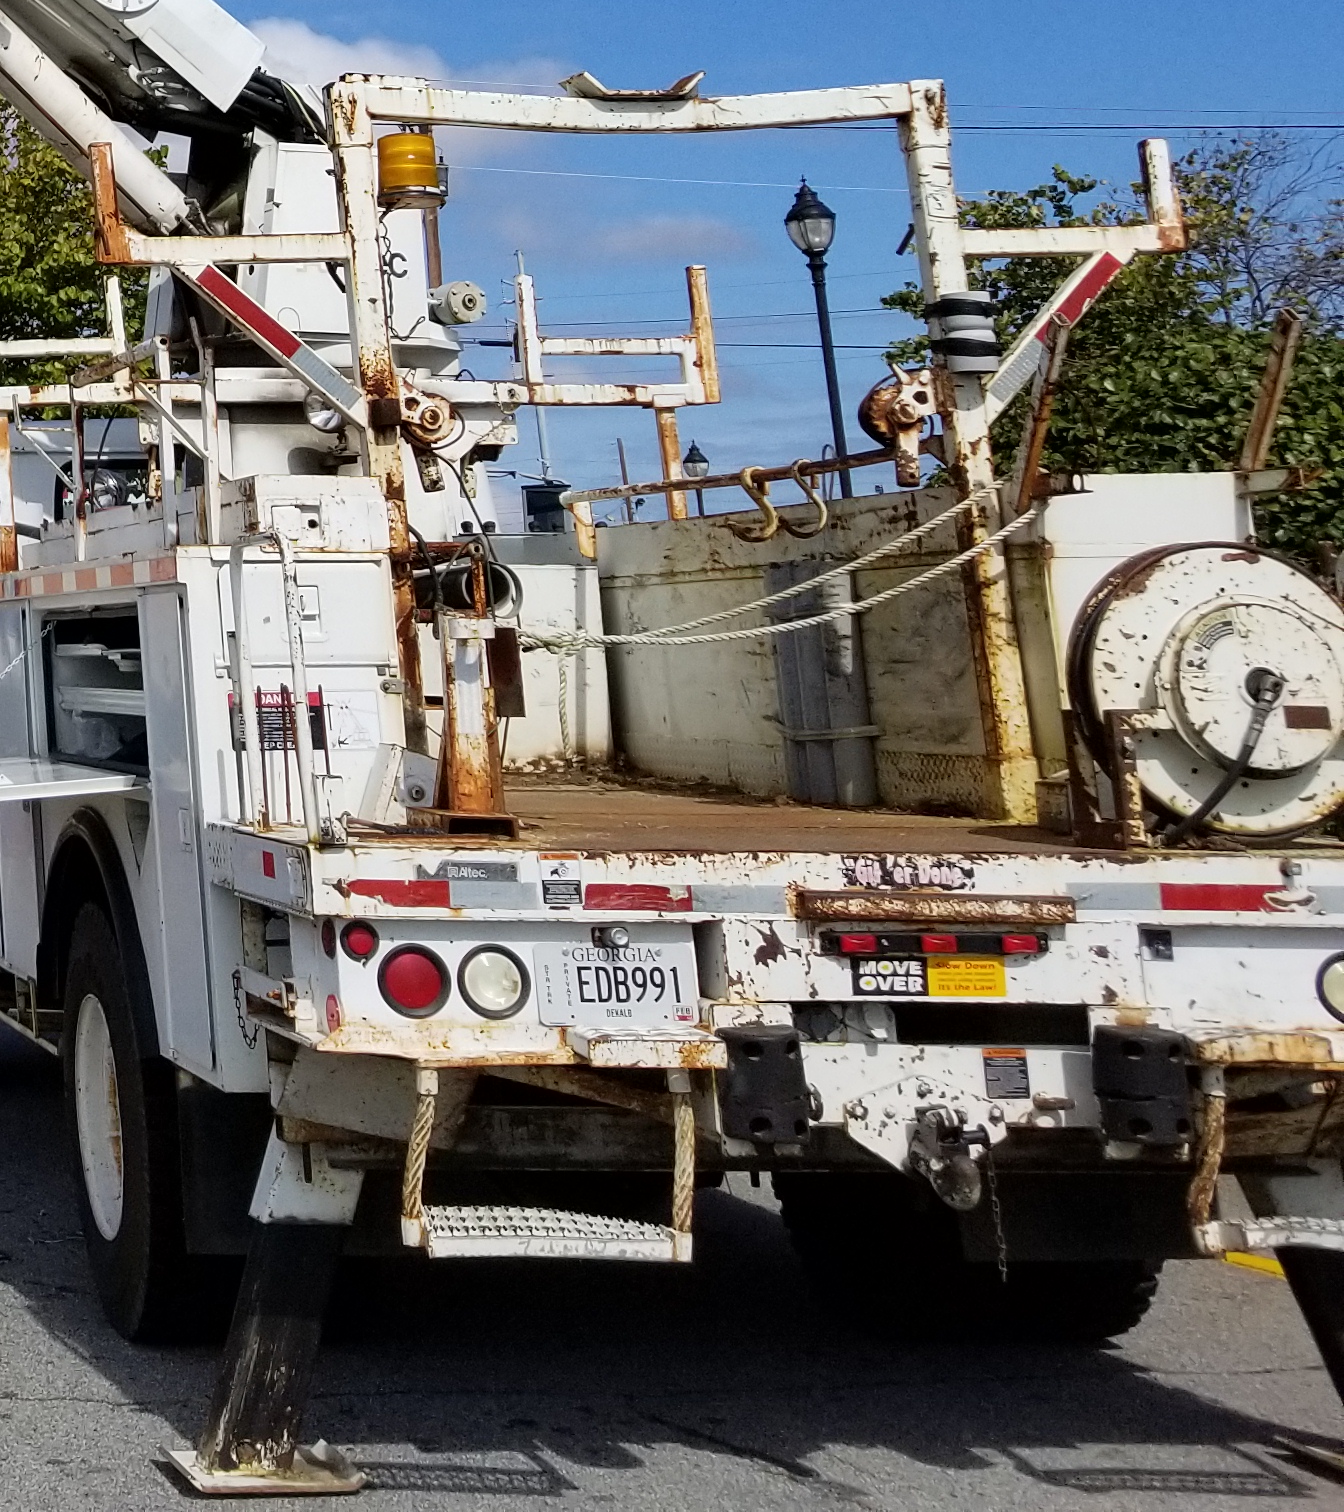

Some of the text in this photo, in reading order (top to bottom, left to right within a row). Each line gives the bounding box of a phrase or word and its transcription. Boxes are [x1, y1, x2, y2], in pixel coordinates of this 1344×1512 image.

[572, 946, 657, 963] GEORGIA
[859, 960, 923, 976] MOVE
[936, 961, 996, 970] Slow Down
[563, 962, 573, 1007] PRIVATE
[577, 965, 682, 1004] EDB991
[859, 976, 924, 993] OVER
[955, 983, 971, 991] the
[974, 983, 997, 991] Law!
[675, 1007, 691, 1015] FEB
